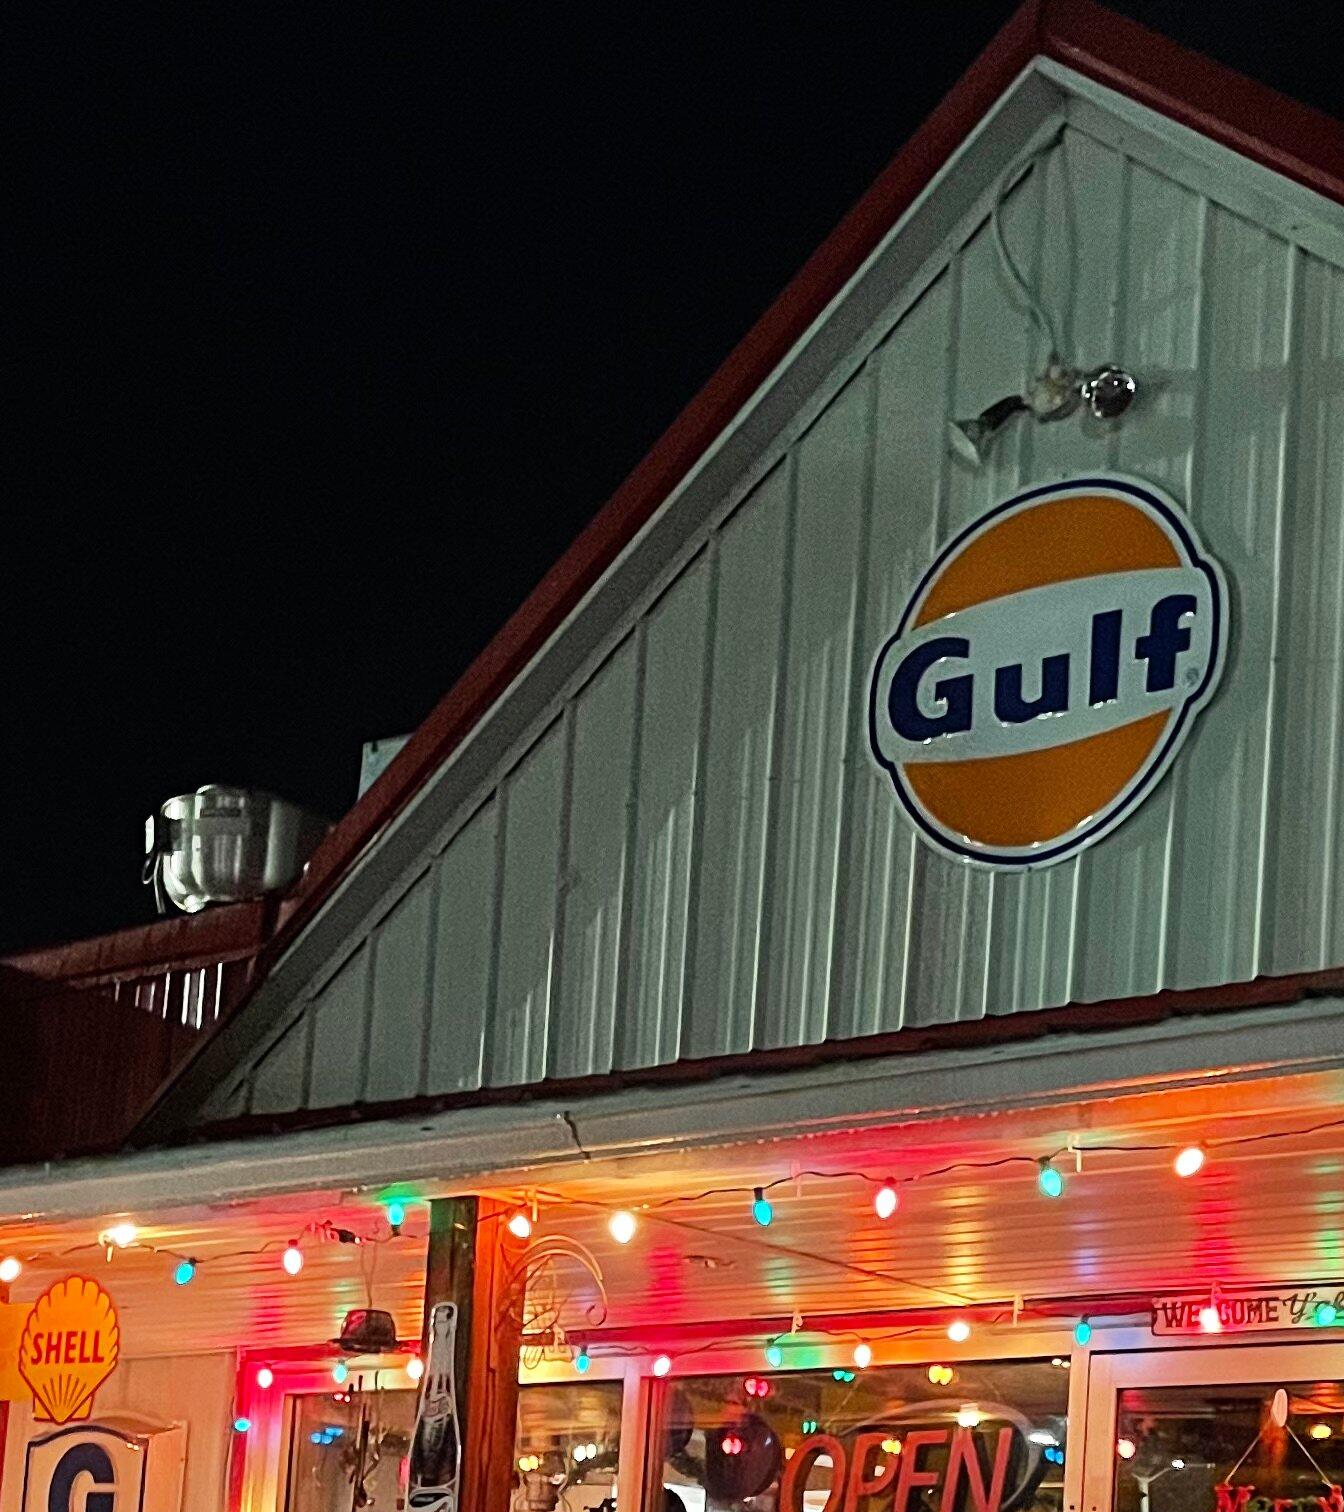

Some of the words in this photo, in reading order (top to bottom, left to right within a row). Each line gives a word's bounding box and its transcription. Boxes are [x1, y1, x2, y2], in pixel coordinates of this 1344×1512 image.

[887, 593, 1198, 743] Gulf
[1161, 1296, 1281, 1328] WECOME
[30, 1330, 105, 1366] SHELL
